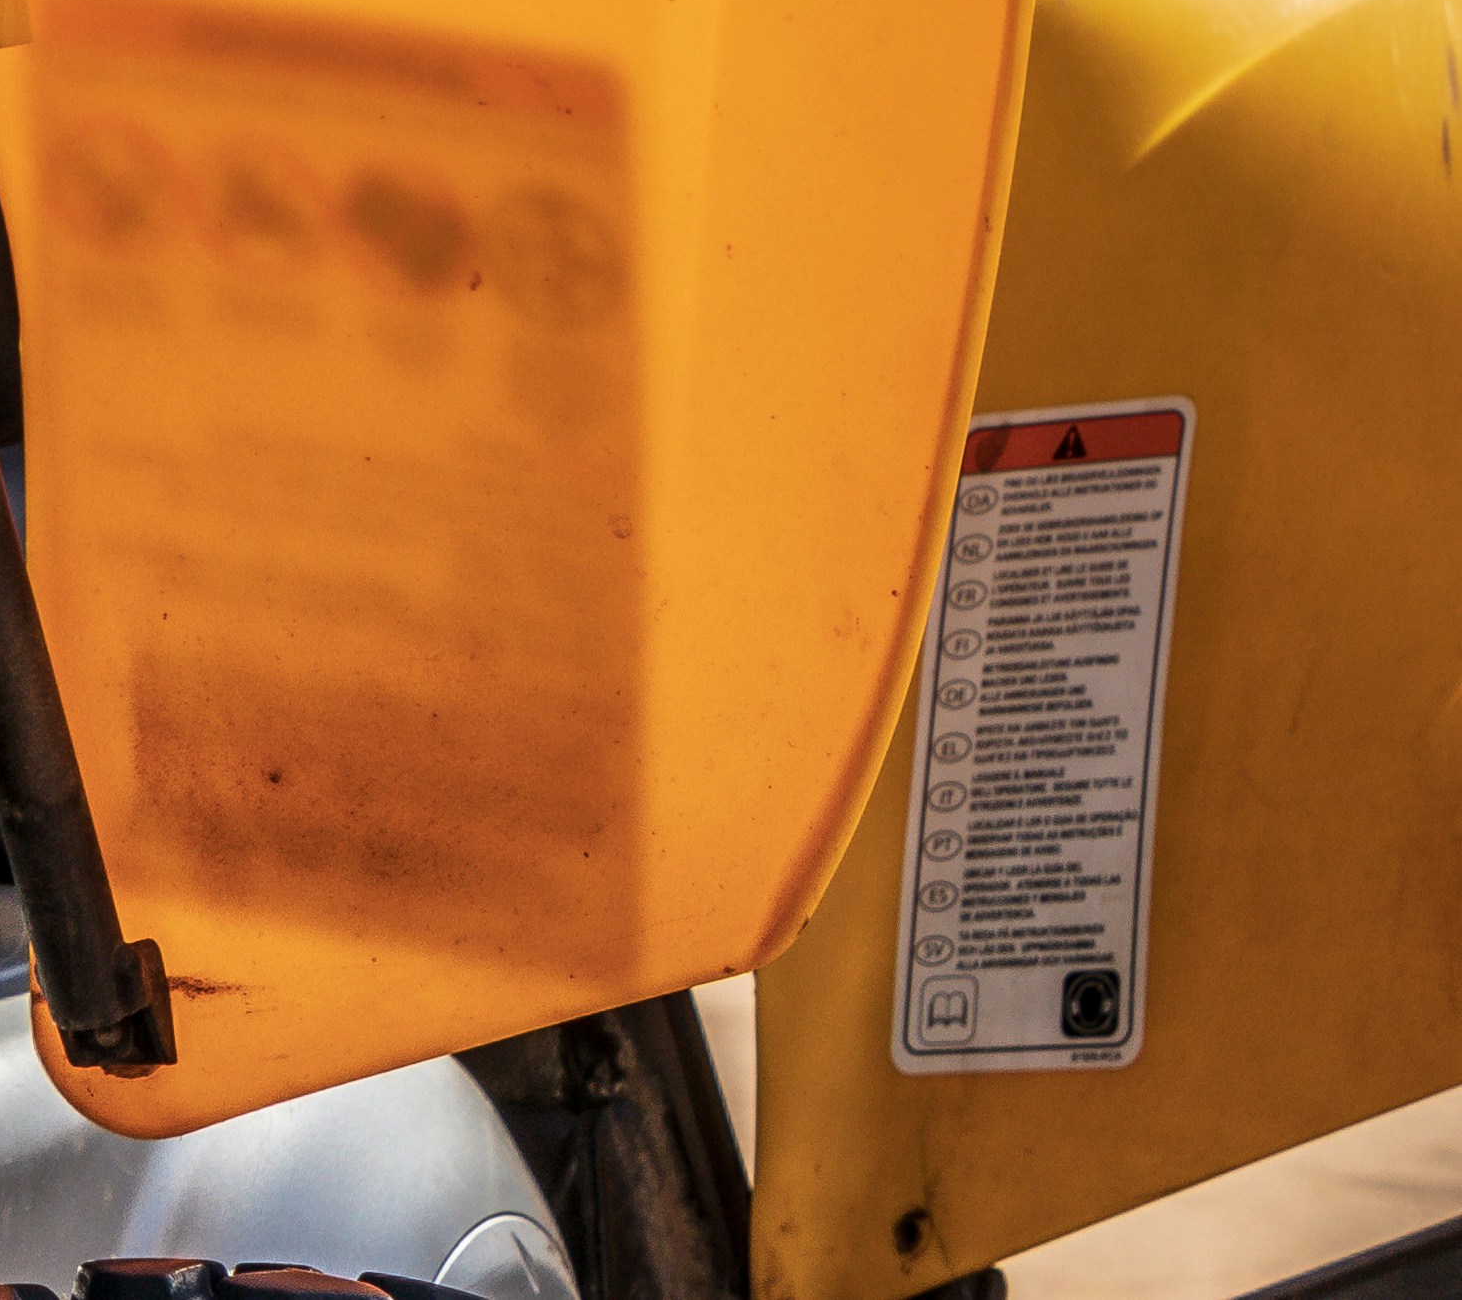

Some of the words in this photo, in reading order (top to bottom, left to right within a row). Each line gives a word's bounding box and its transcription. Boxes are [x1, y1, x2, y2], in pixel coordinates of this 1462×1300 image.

[957, 587, 978, 603] FR
[932, 837, 952, 852] PT
[929, 889, 949, 903] ES
